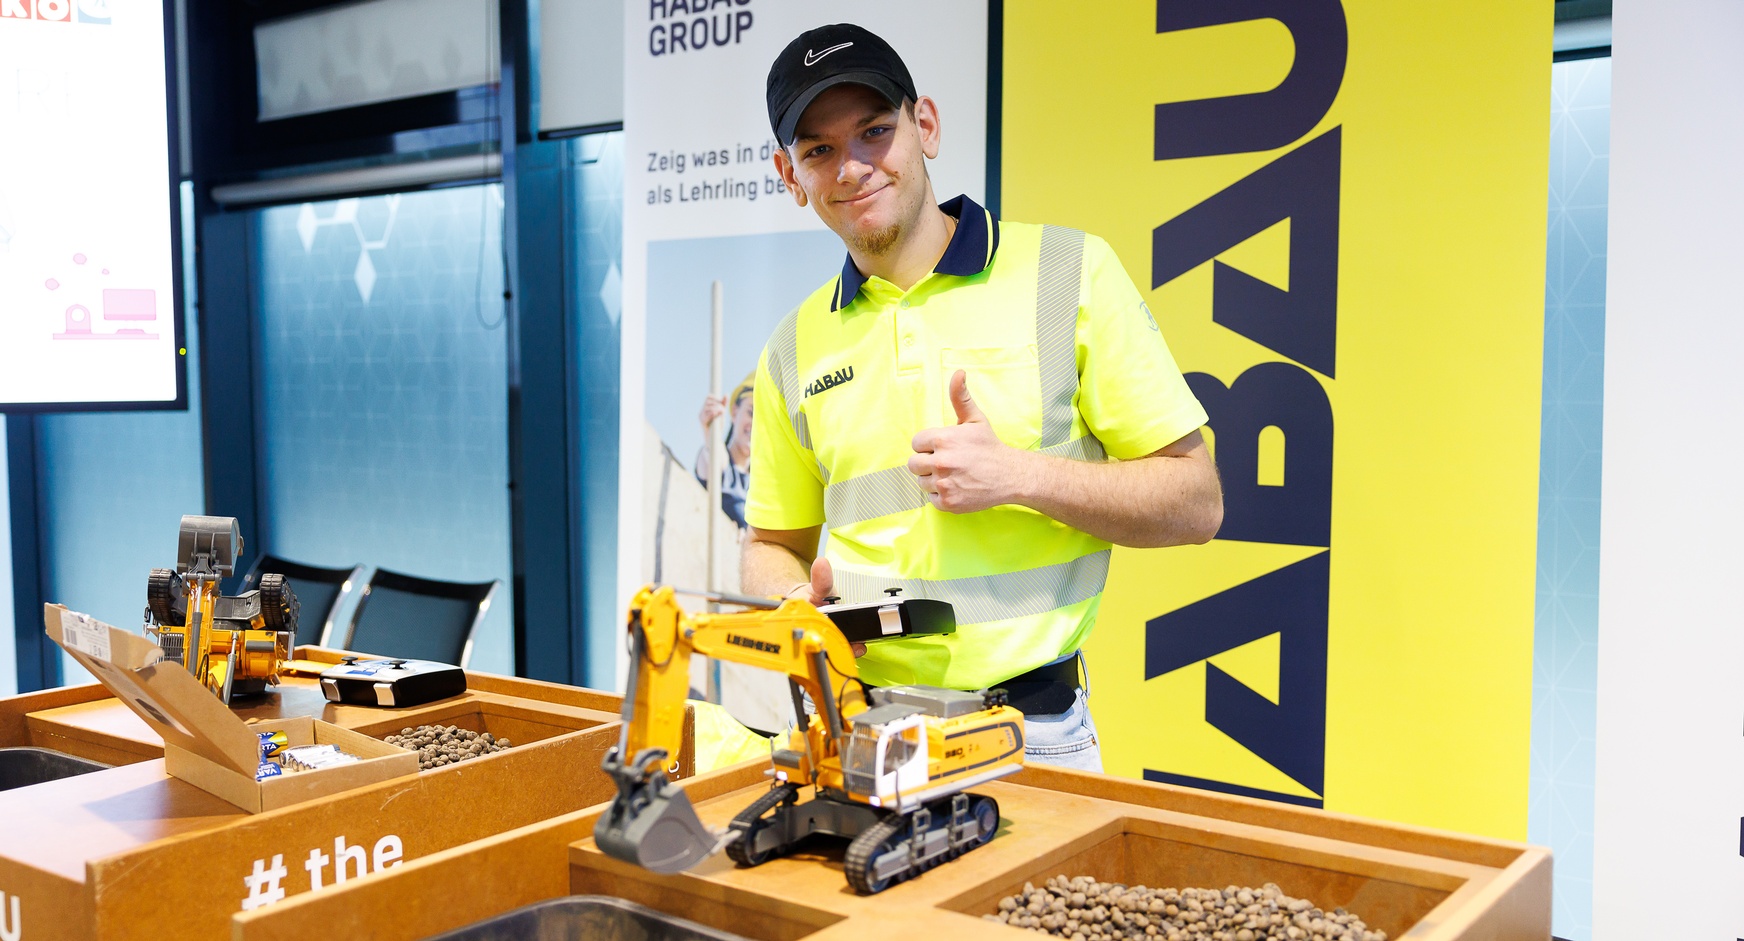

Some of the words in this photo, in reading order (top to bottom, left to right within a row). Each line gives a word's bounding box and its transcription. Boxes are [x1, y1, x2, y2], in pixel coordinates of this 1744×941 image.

[650, 11, 753, 56] GROUP
[648, 151, 686, 173] Zeig
[693, 149, 729, 167] was
[736, 143, 753, 164] in
[760, 139, 782, 161] di
[647, 183, 673, 205] als
[680, 178, 757, 201] Lehrling
[765, 174, 786, 195] be
[804, 365, 854, 399] HABAU
[1143, 0, 1348, 808] ABAU
[261, 743, 278, 751] RTA
[255, 766, 278, 777] VAR
[305, 835, 403, 891] the
